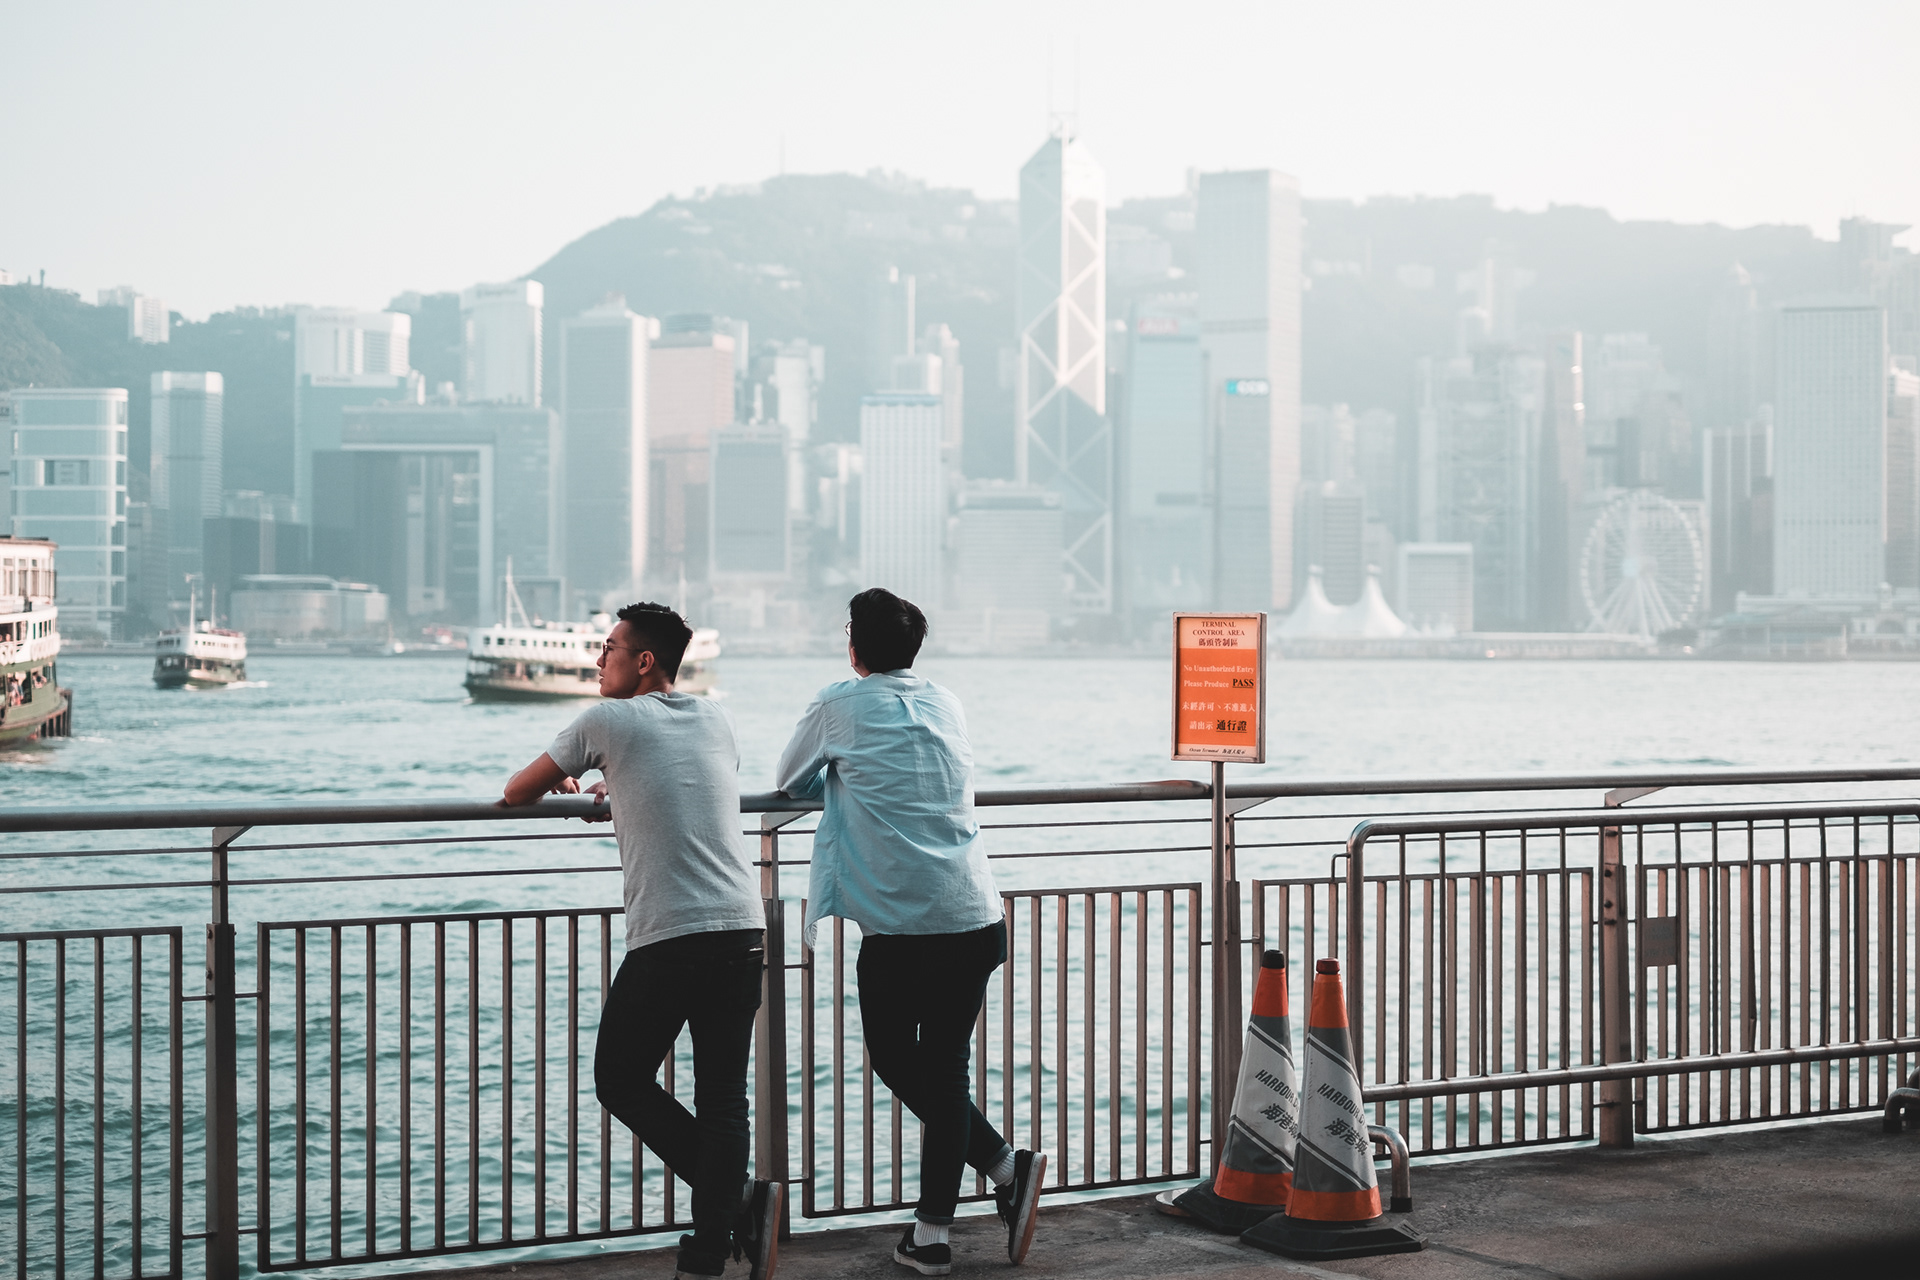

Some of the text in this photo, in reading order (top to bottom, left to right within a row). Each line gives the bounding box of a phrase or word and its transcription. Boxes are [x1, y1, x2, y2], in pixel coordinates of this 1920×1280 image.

[1194, 665, 1236, 673] Unauthorized
[1237, 666, 1254, 674] Entry
[1204, 680, 1229, 688] Produce
[1233, 678, 1254, 687] PASS
[1255, 1069, 1295, 1103] HARBOUR
[1316, 1082, 1361, 1119] HARBOUR
[1324, 1117, 1369, 1156] 海港城
